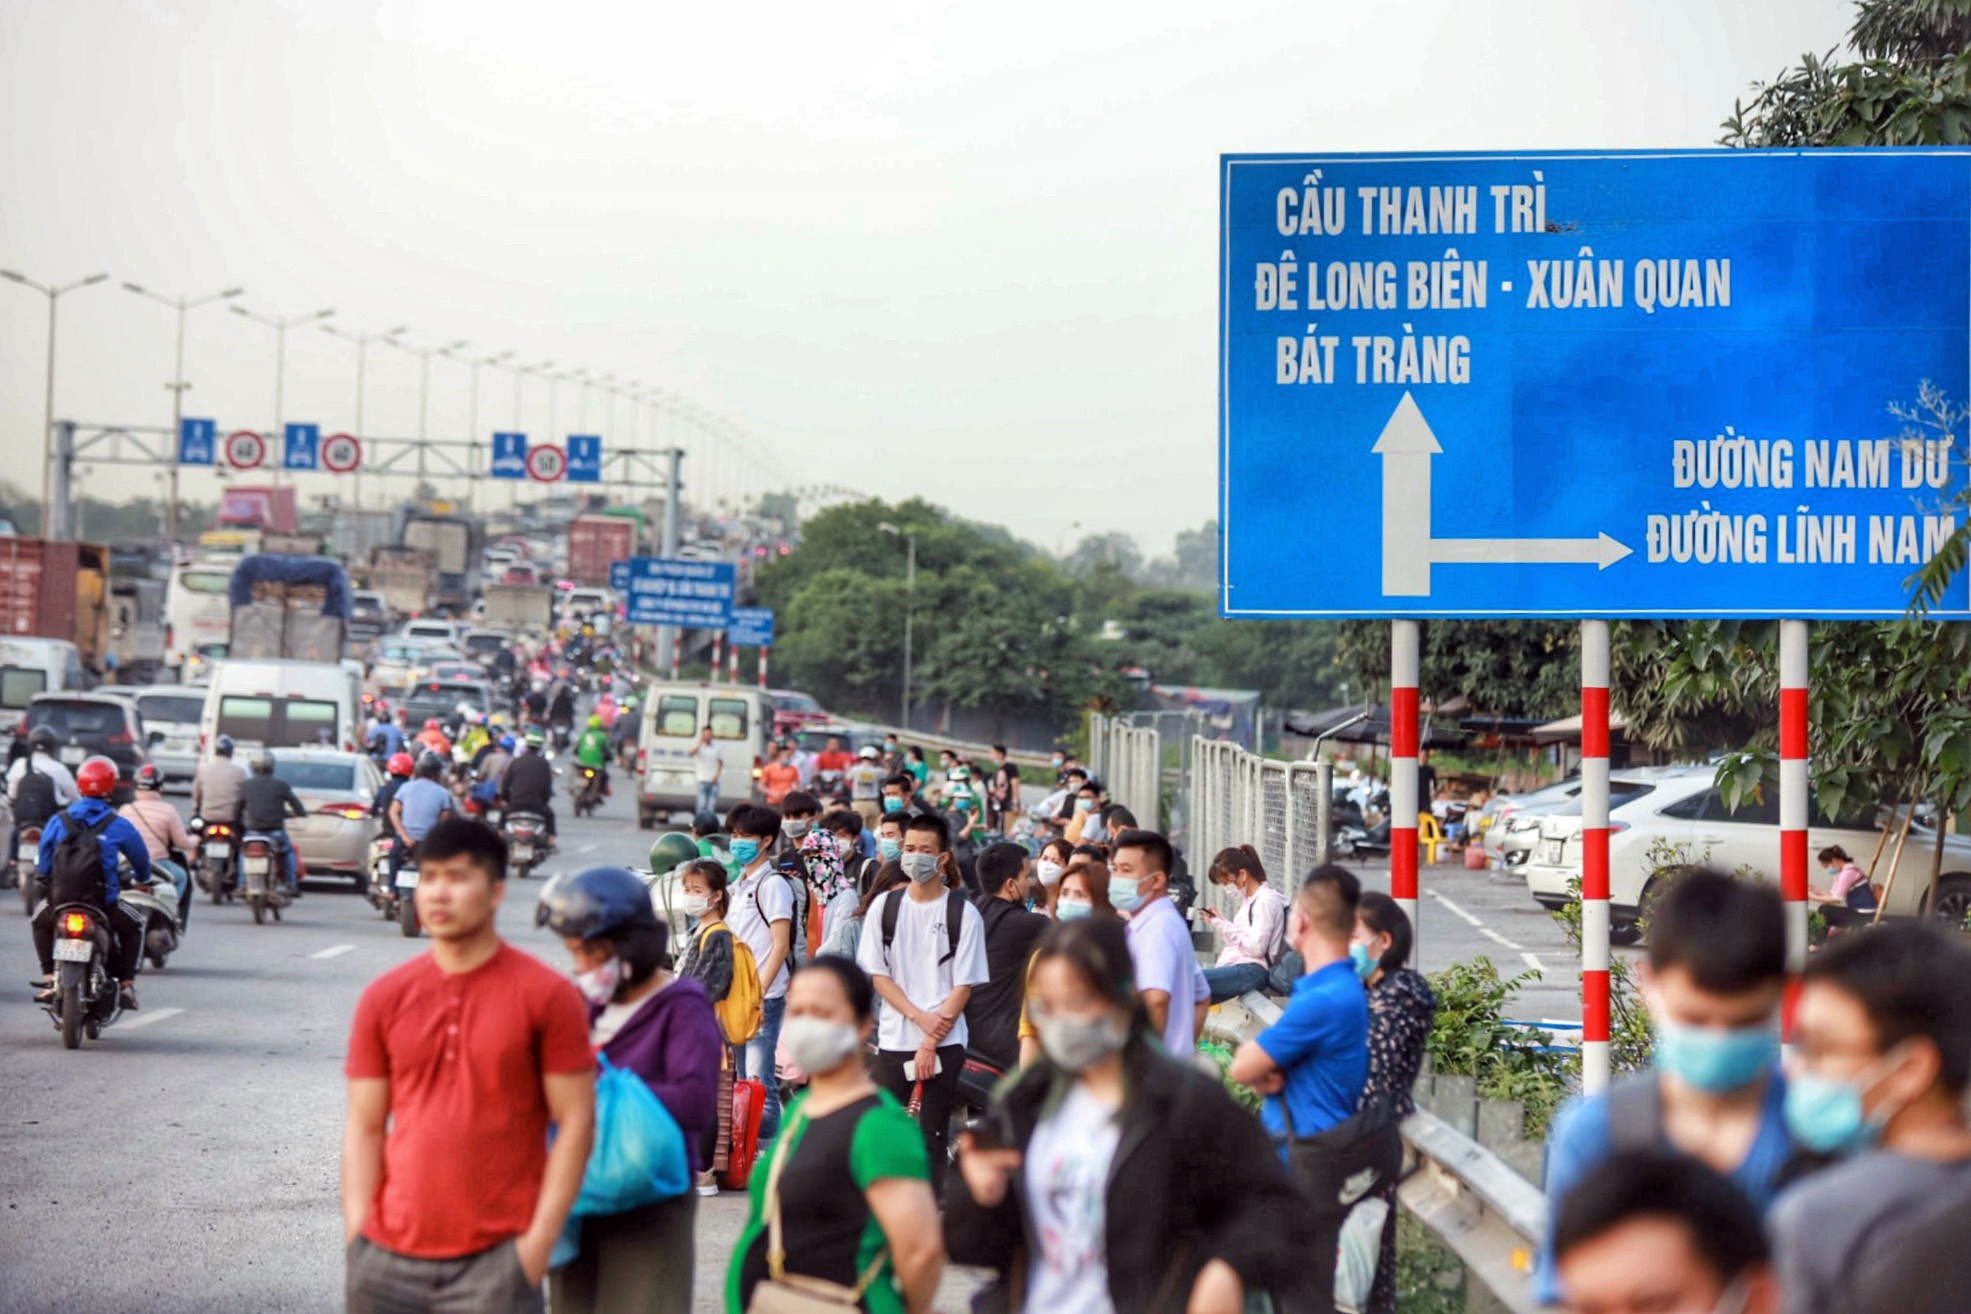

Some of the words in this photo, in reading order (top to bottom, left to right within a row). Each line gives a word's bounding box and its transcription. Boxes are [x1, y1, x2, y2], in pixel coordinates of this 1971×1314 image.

[1276, 169, 1345, 236] CẦU
[1358, 186, 1477, 235] THANH
[1490, 170, 1546, 234] TRÌ
[1255, 250, 1298, 311] ĐÊ
[1308, 261, 1397, 311] LONG
[1407, 248, 1488, 309] BIÊN
[1526, 246, 1624, 309] XUÂN
[1634, 258, 1731, 314] QUAN
[1276, 323, 1339, 384] BÁT
[1352, 323, 1471, 385] TRÀNG
[1672, 426, 1794, 489] ĐƯỜNG
[1805, 439, 1890, 489] NAM
[1646, 500, 1768, 564] ĐƯỜNG
[1777, 505, 1856, 563] LĨNH
[1868, 515, 1956, 564] NAM
